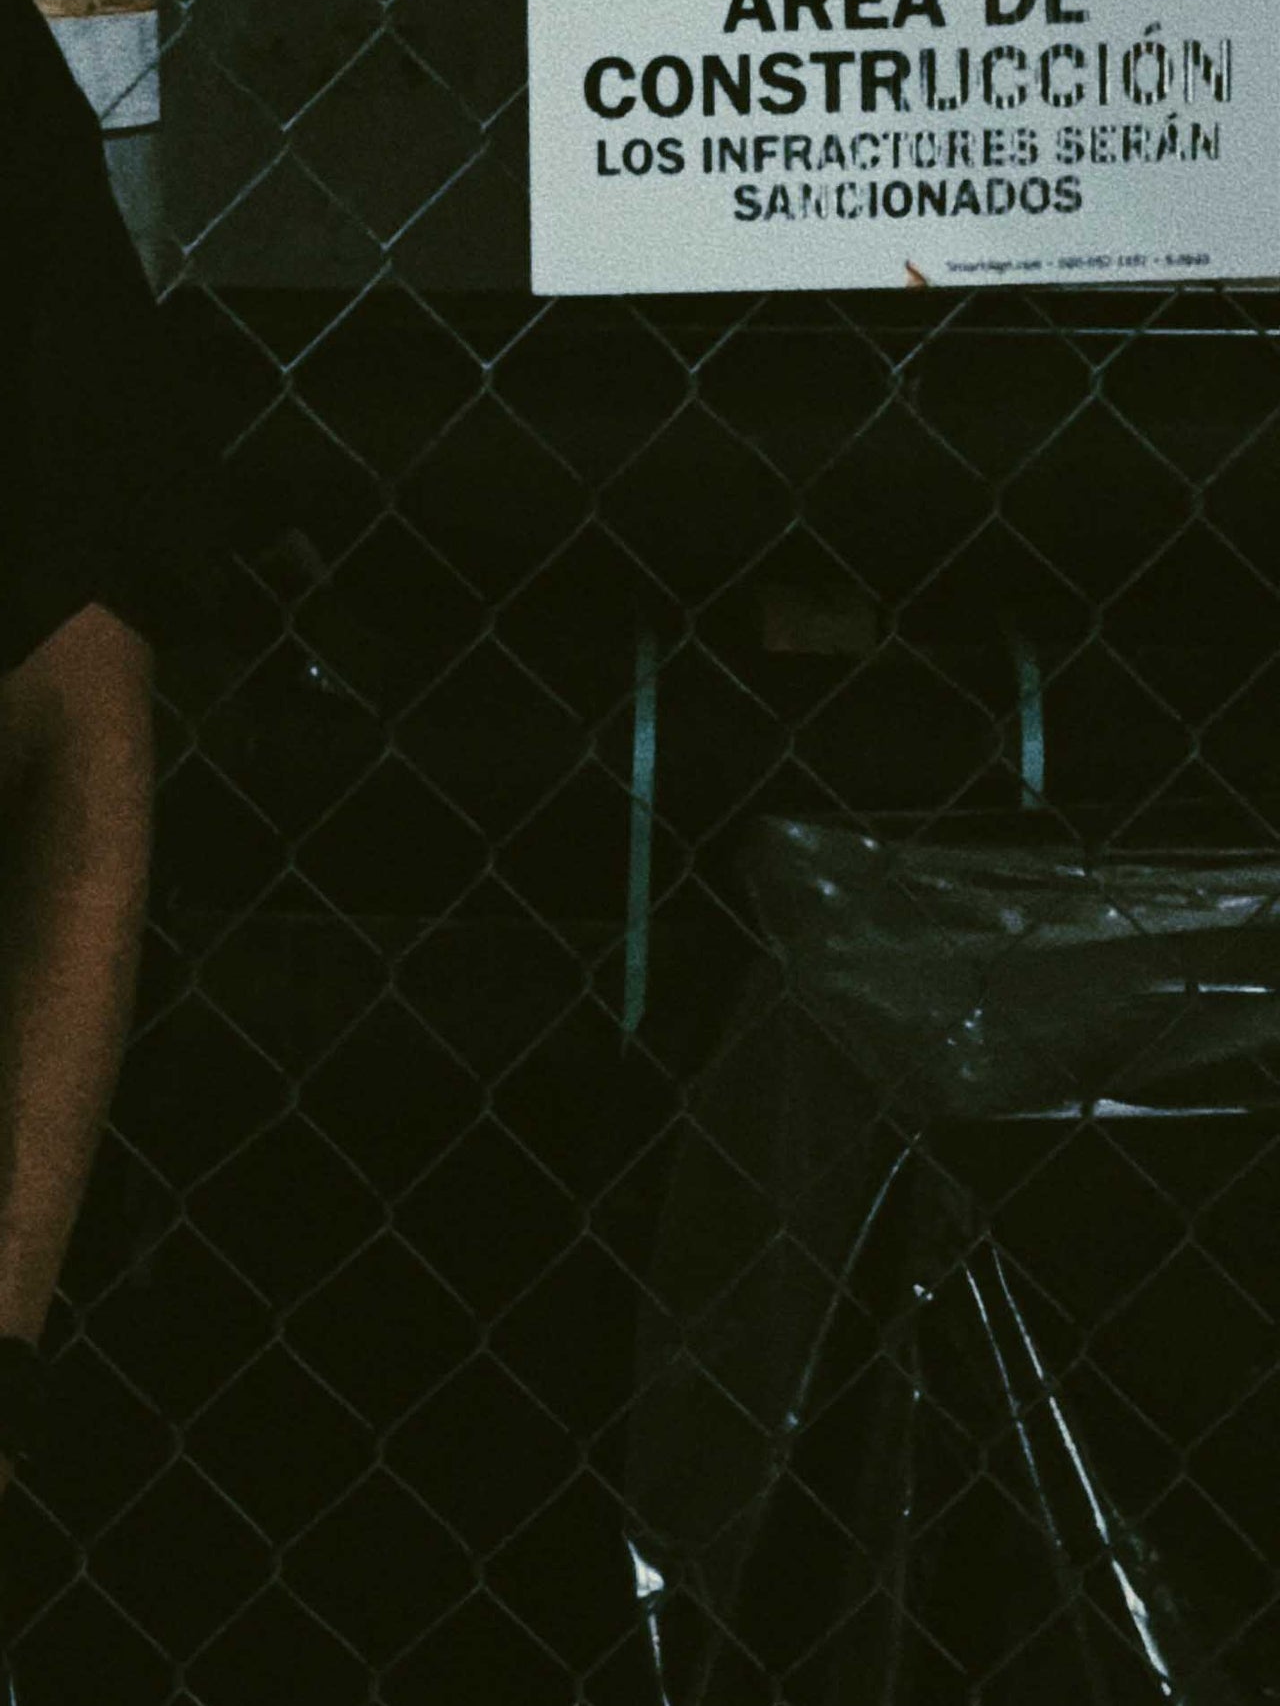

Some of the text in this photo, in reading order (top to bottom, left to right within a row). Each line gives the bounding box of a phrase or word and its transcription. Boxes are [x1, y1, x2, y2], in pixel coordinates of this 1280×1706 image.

[583, 23, 1233, 120] CONSTRUCCIÓN
[596, 112, 1221, 177] LOS INFRACTORES SERÁN
[733, 174, 1084, 222] SANCIONADOS
